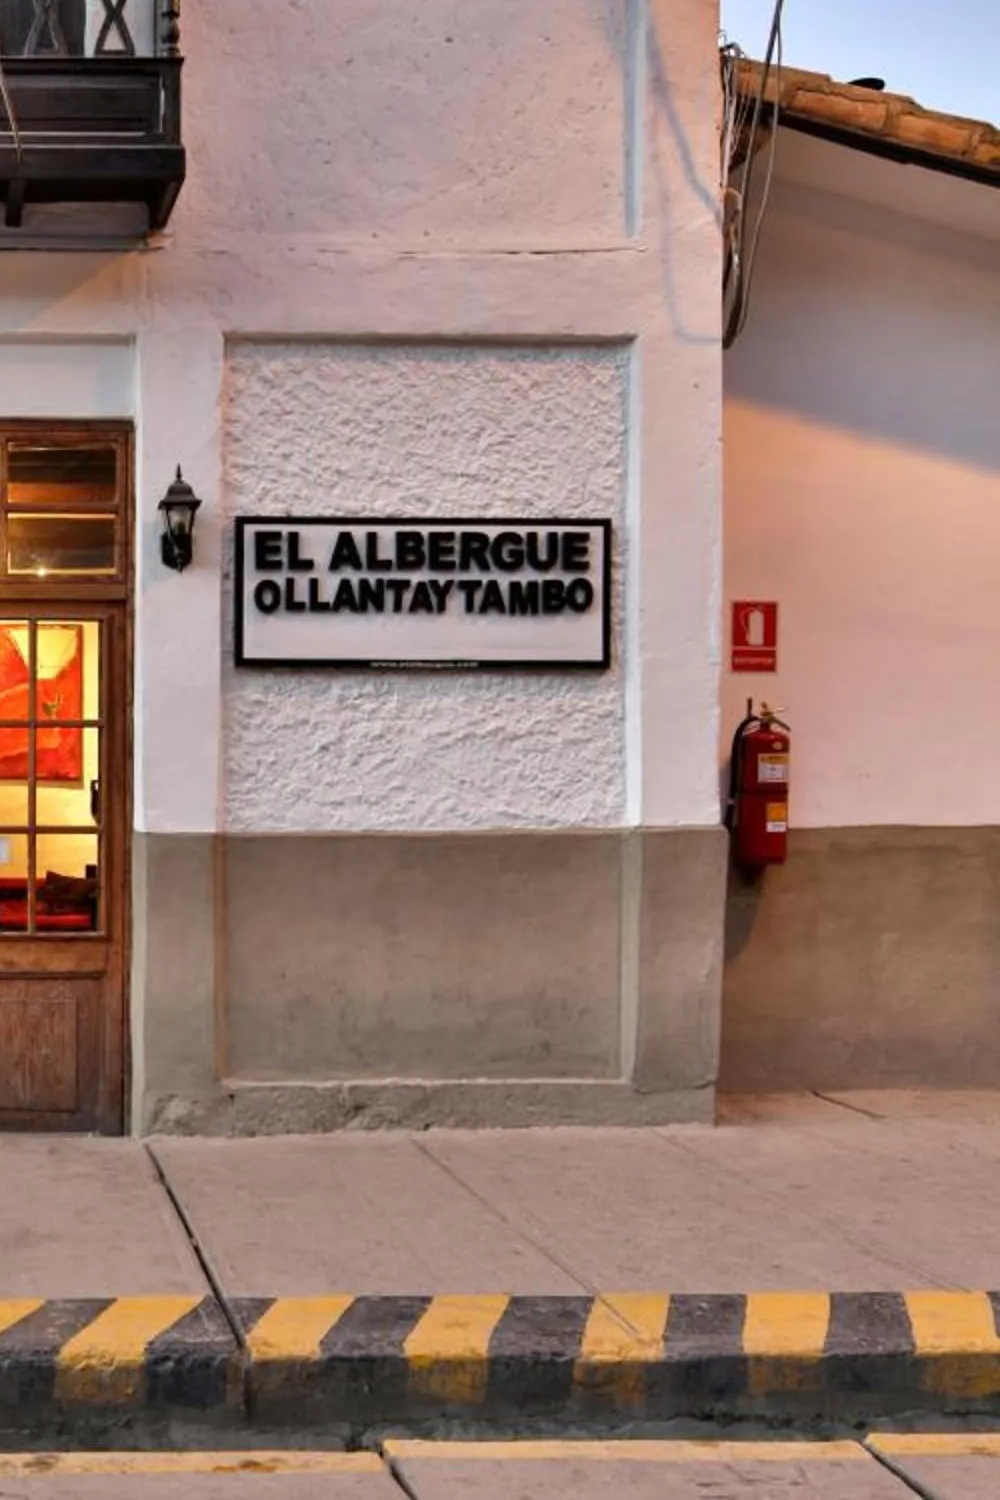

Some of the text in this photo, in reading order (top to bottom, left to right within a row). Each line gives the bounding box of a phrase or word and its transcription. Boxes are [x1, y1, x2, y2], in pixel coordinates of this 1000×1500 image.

[254, 531, 591, 571] EL ALBERGUE
[254, 577, 594, 615] OLLANTAYTAMBO
